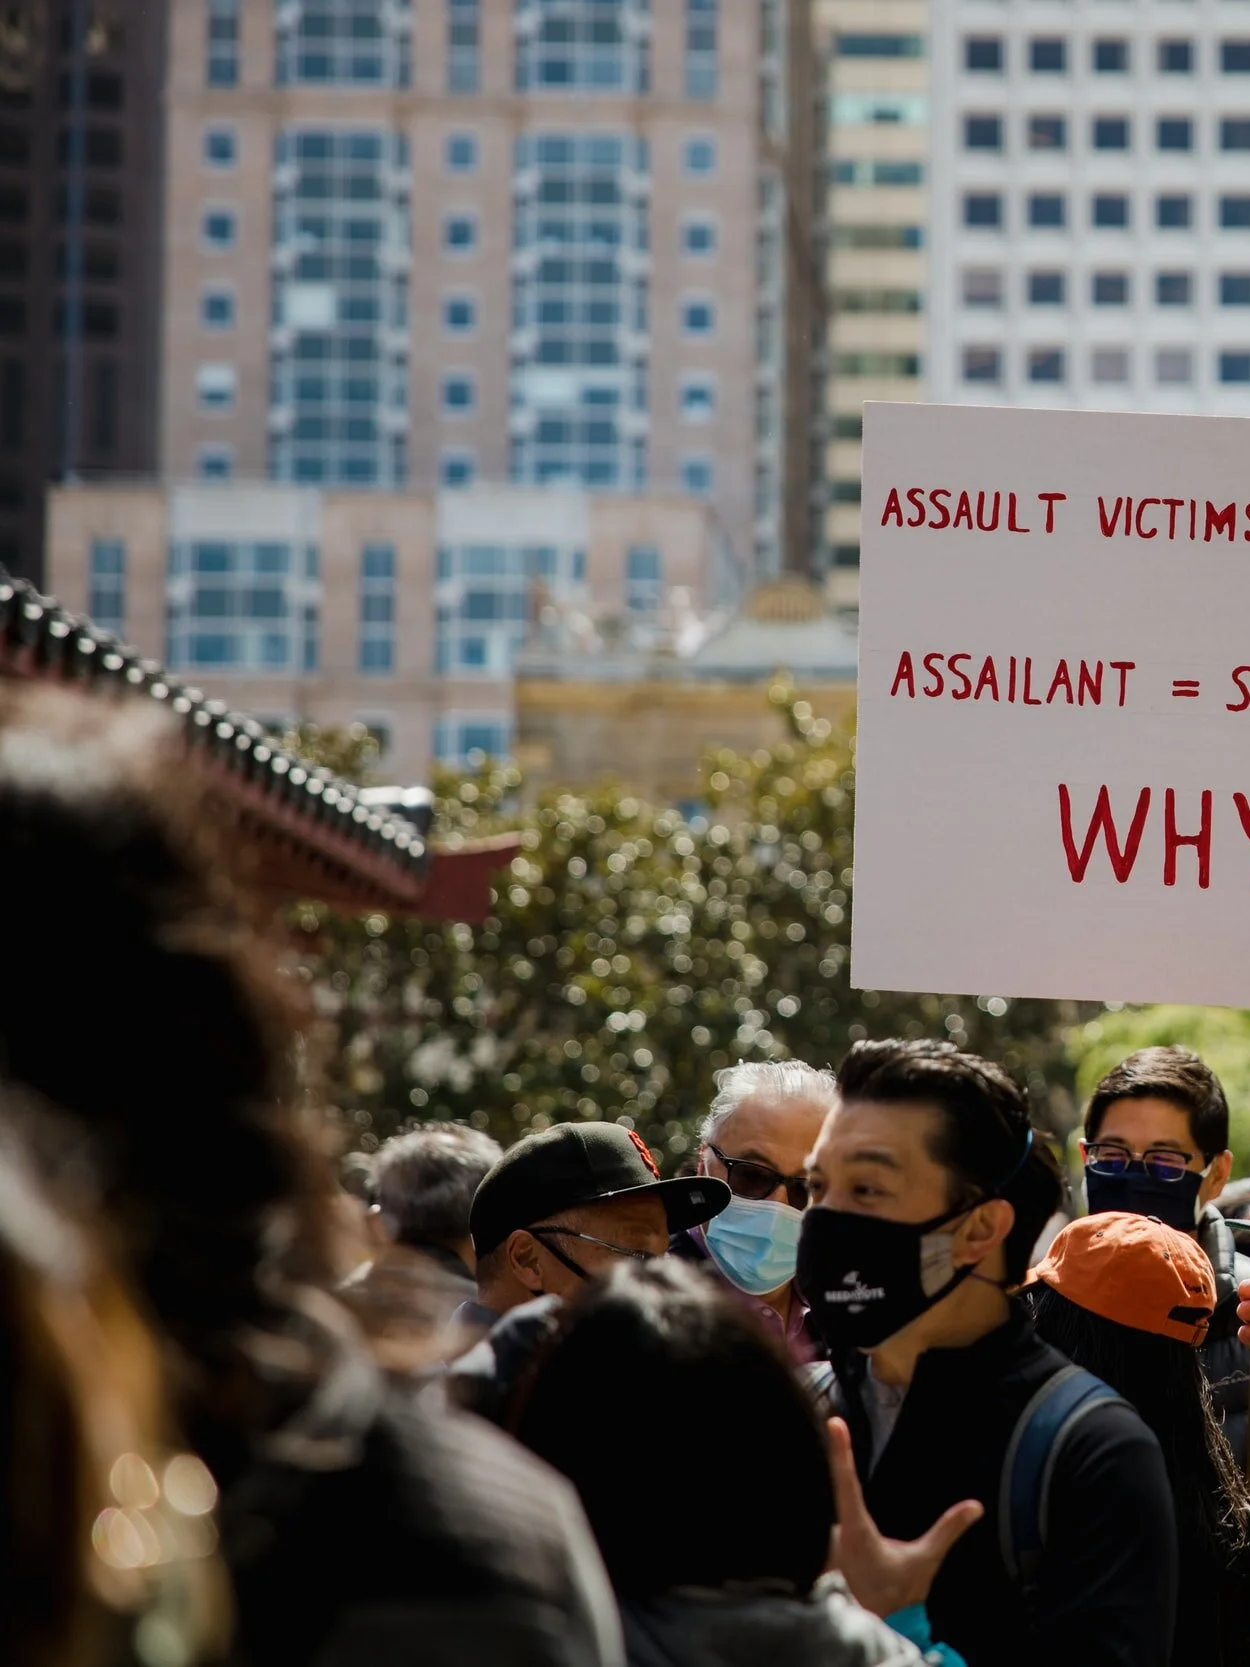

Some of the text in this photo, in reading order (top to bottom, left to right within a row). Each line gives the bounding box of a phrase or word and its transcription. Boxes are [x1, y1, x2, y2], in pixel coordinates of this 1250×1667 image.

[880, 487, 1068, 535] ASSAULT
[889, 650, 1137, 708] ASSAILANT
[1171, 679, 1201, 699] =
